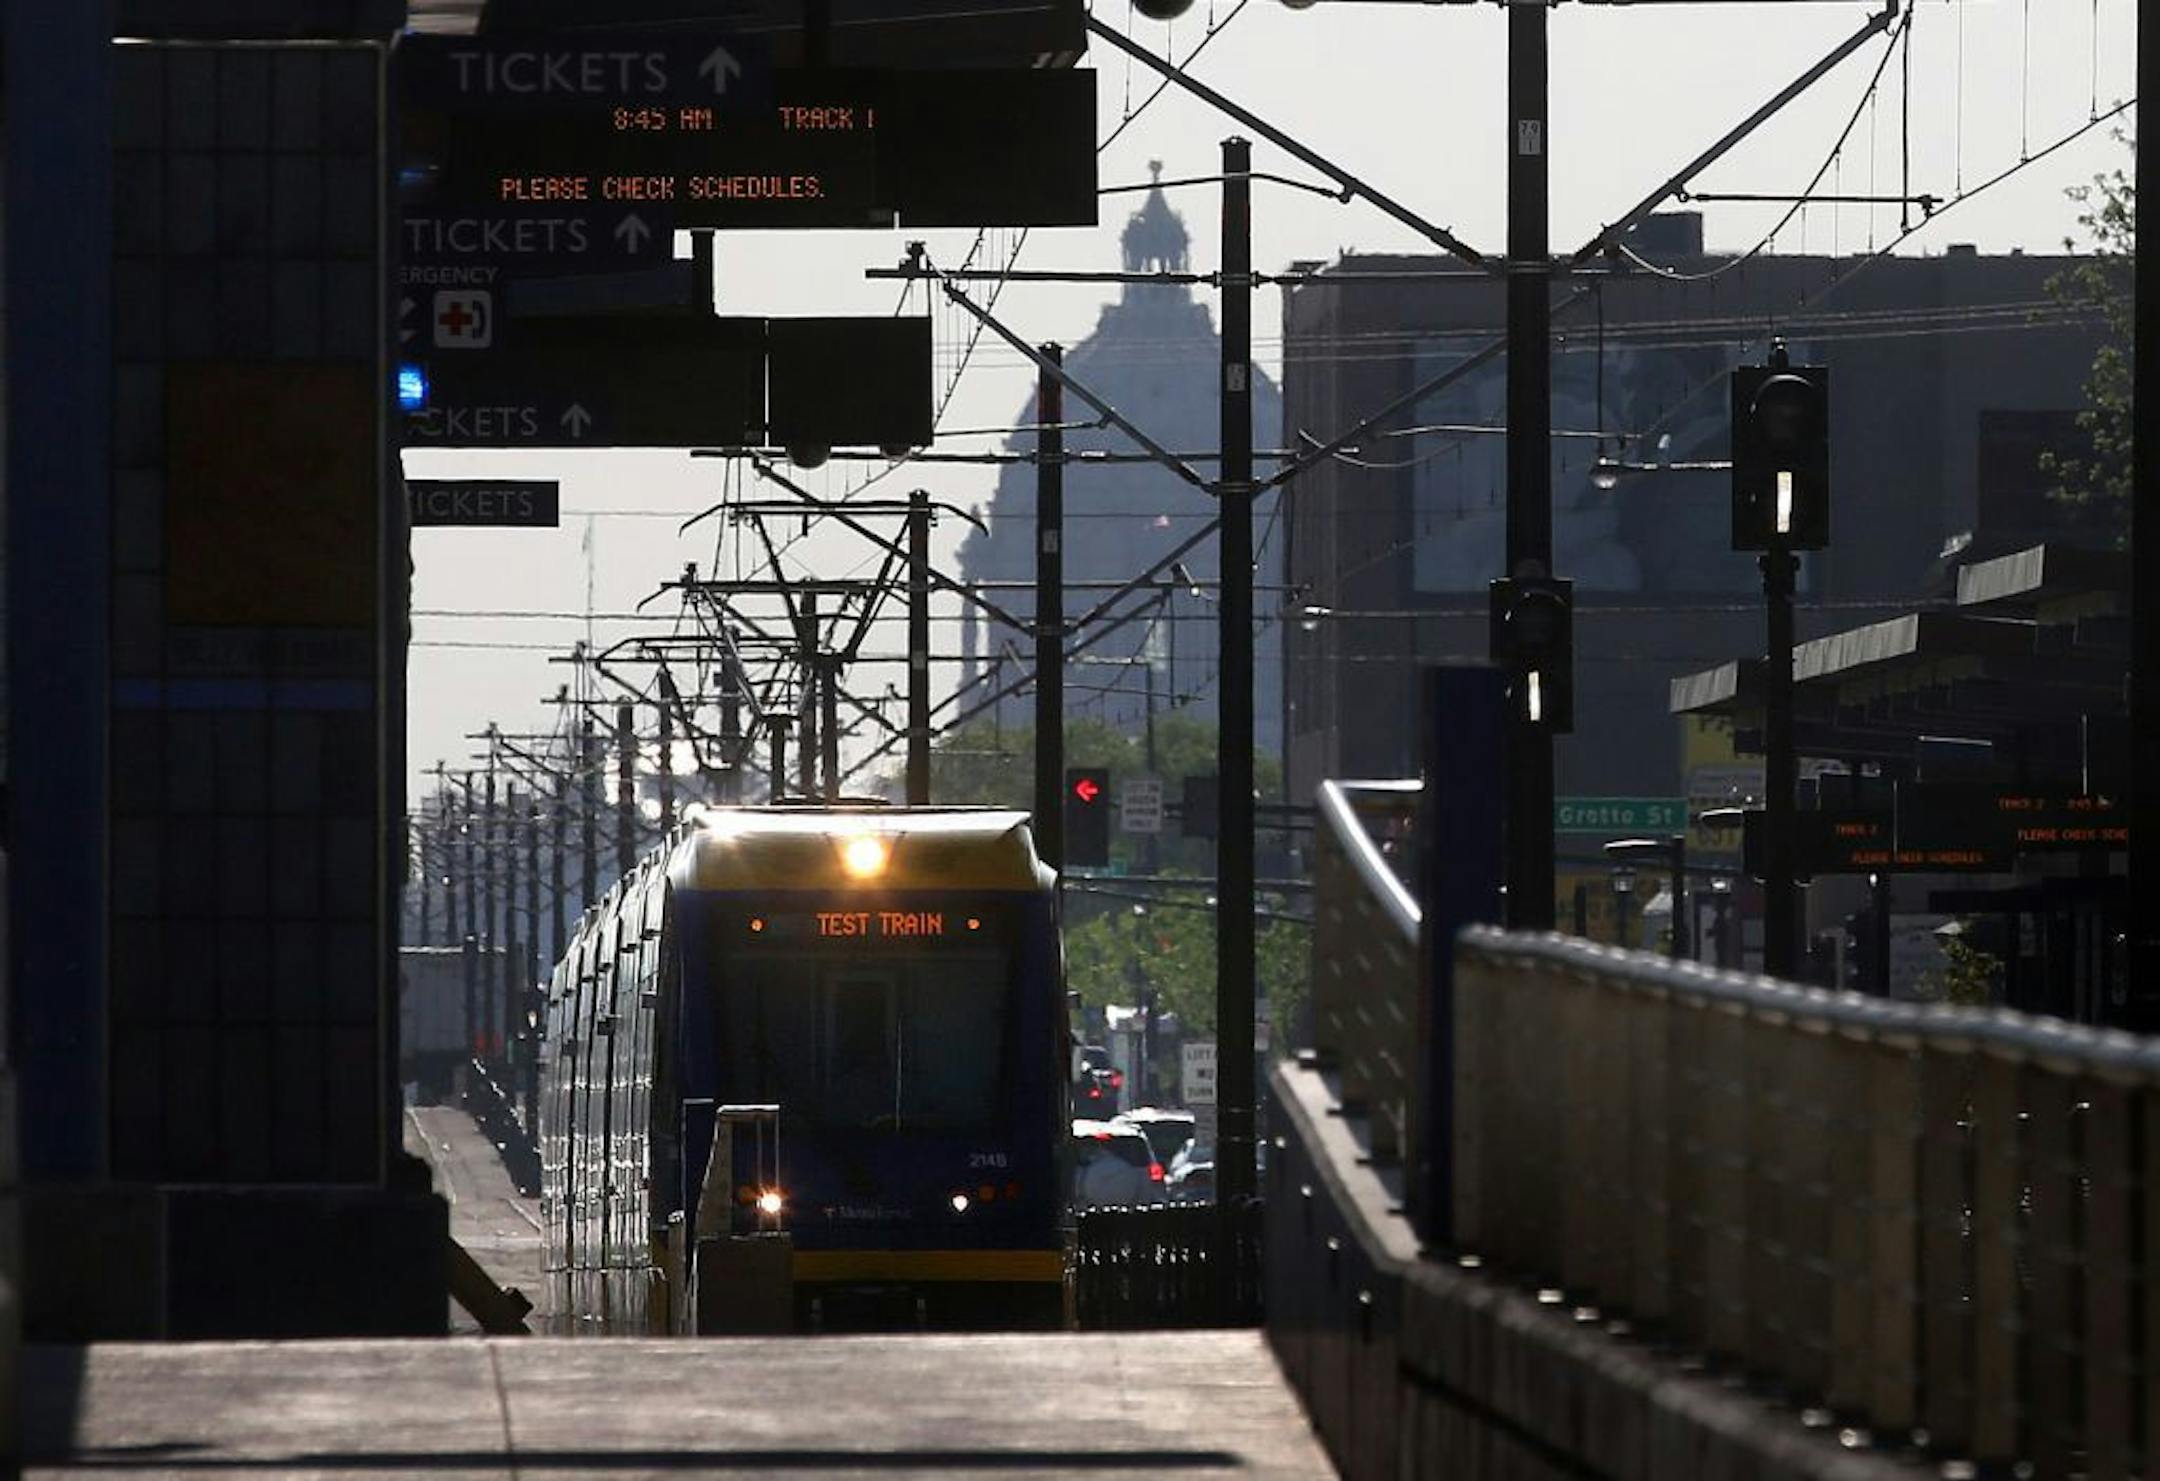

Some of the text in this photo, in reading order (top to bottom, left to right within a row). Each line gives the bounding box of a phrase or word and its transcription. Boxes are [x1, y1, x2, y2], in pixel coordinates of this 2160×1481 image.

[448, 52, 667, 93] TICKETS
[613, 107, 666, 130] 8:45
[679, 107, 714, 130] AM
[779, 107, 853, 129] TRACK
[501, 176, 826, 200] PLEASE CHECK SCHEDULES.
[403, 218, 588, 253] TICKETS
[1559, 806, 1673, 825] Grotto St
[817, 911, 944, 936] TEST TRAIN
